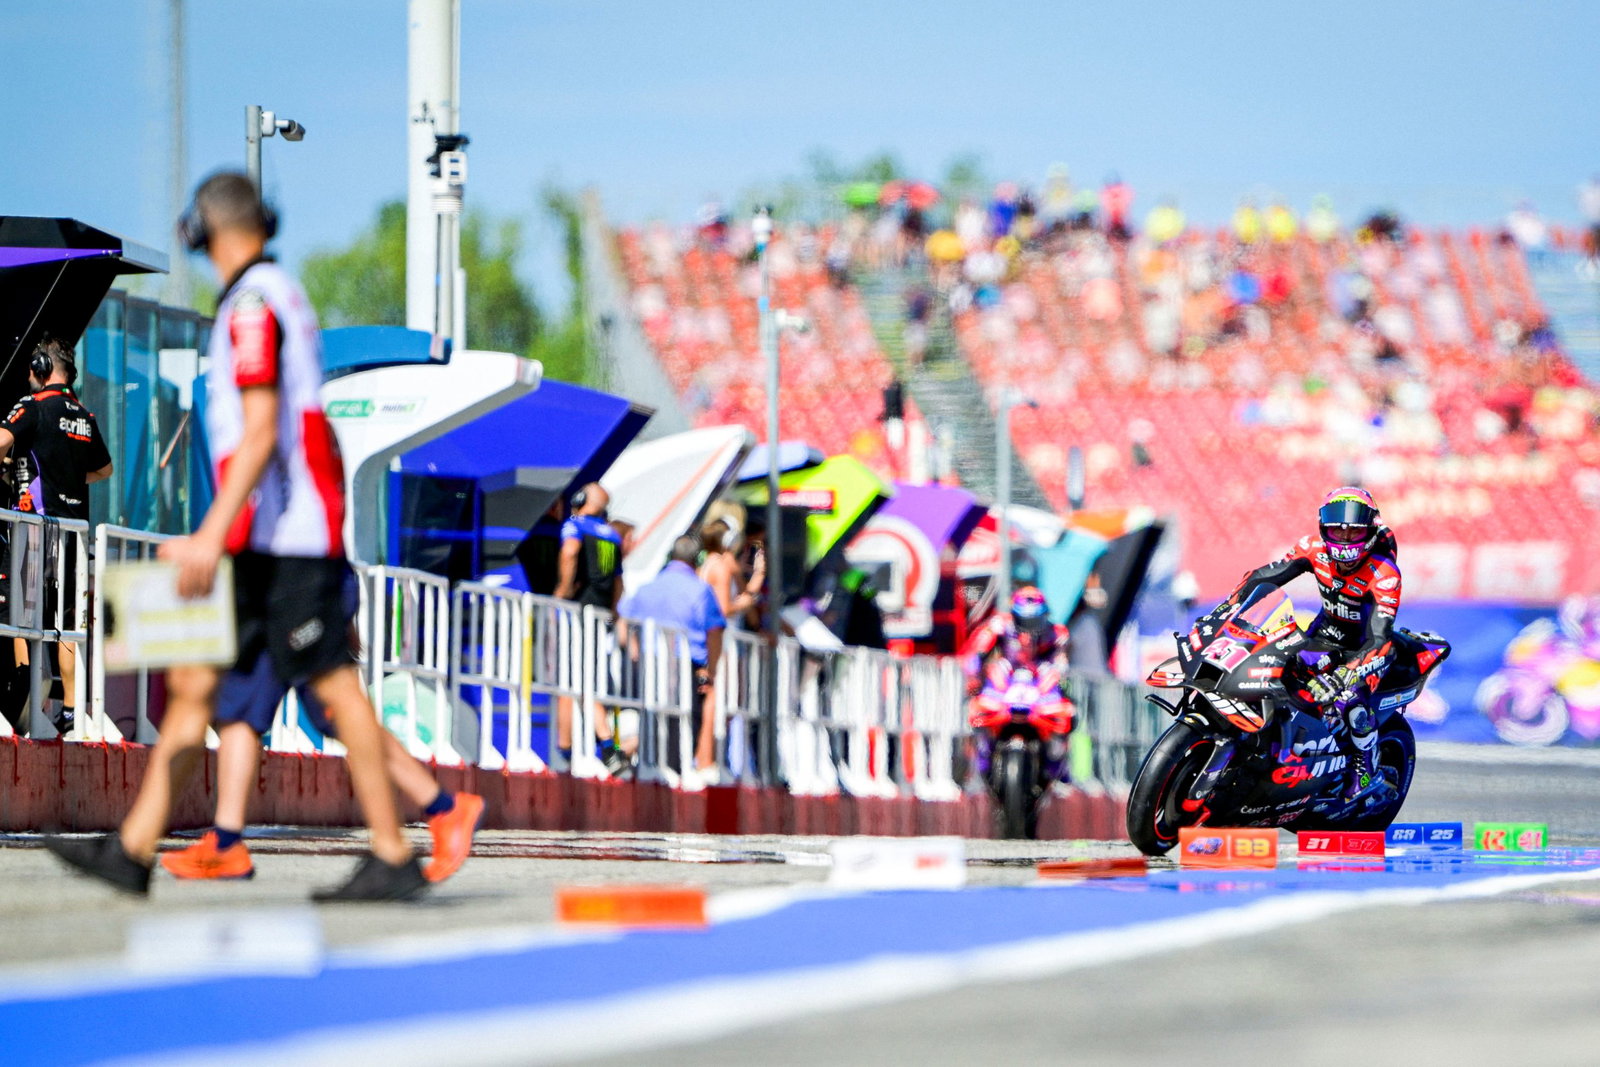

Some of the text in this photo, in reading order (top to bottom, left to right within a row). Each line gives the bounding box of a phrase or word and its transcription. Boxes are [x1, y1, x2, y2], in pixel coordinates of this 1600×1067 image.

[59, 416, 92, 437] aprilia
[1331, 547, 1360, 560] RAW
[1201, 637, 1251, 674] 41
[1258, 654, 1277, 665] sky
[1430, 829, 1455, 841] 25
[1235, 838, 1270, 857] 33
[1306, 838, 1331, 850] 31
